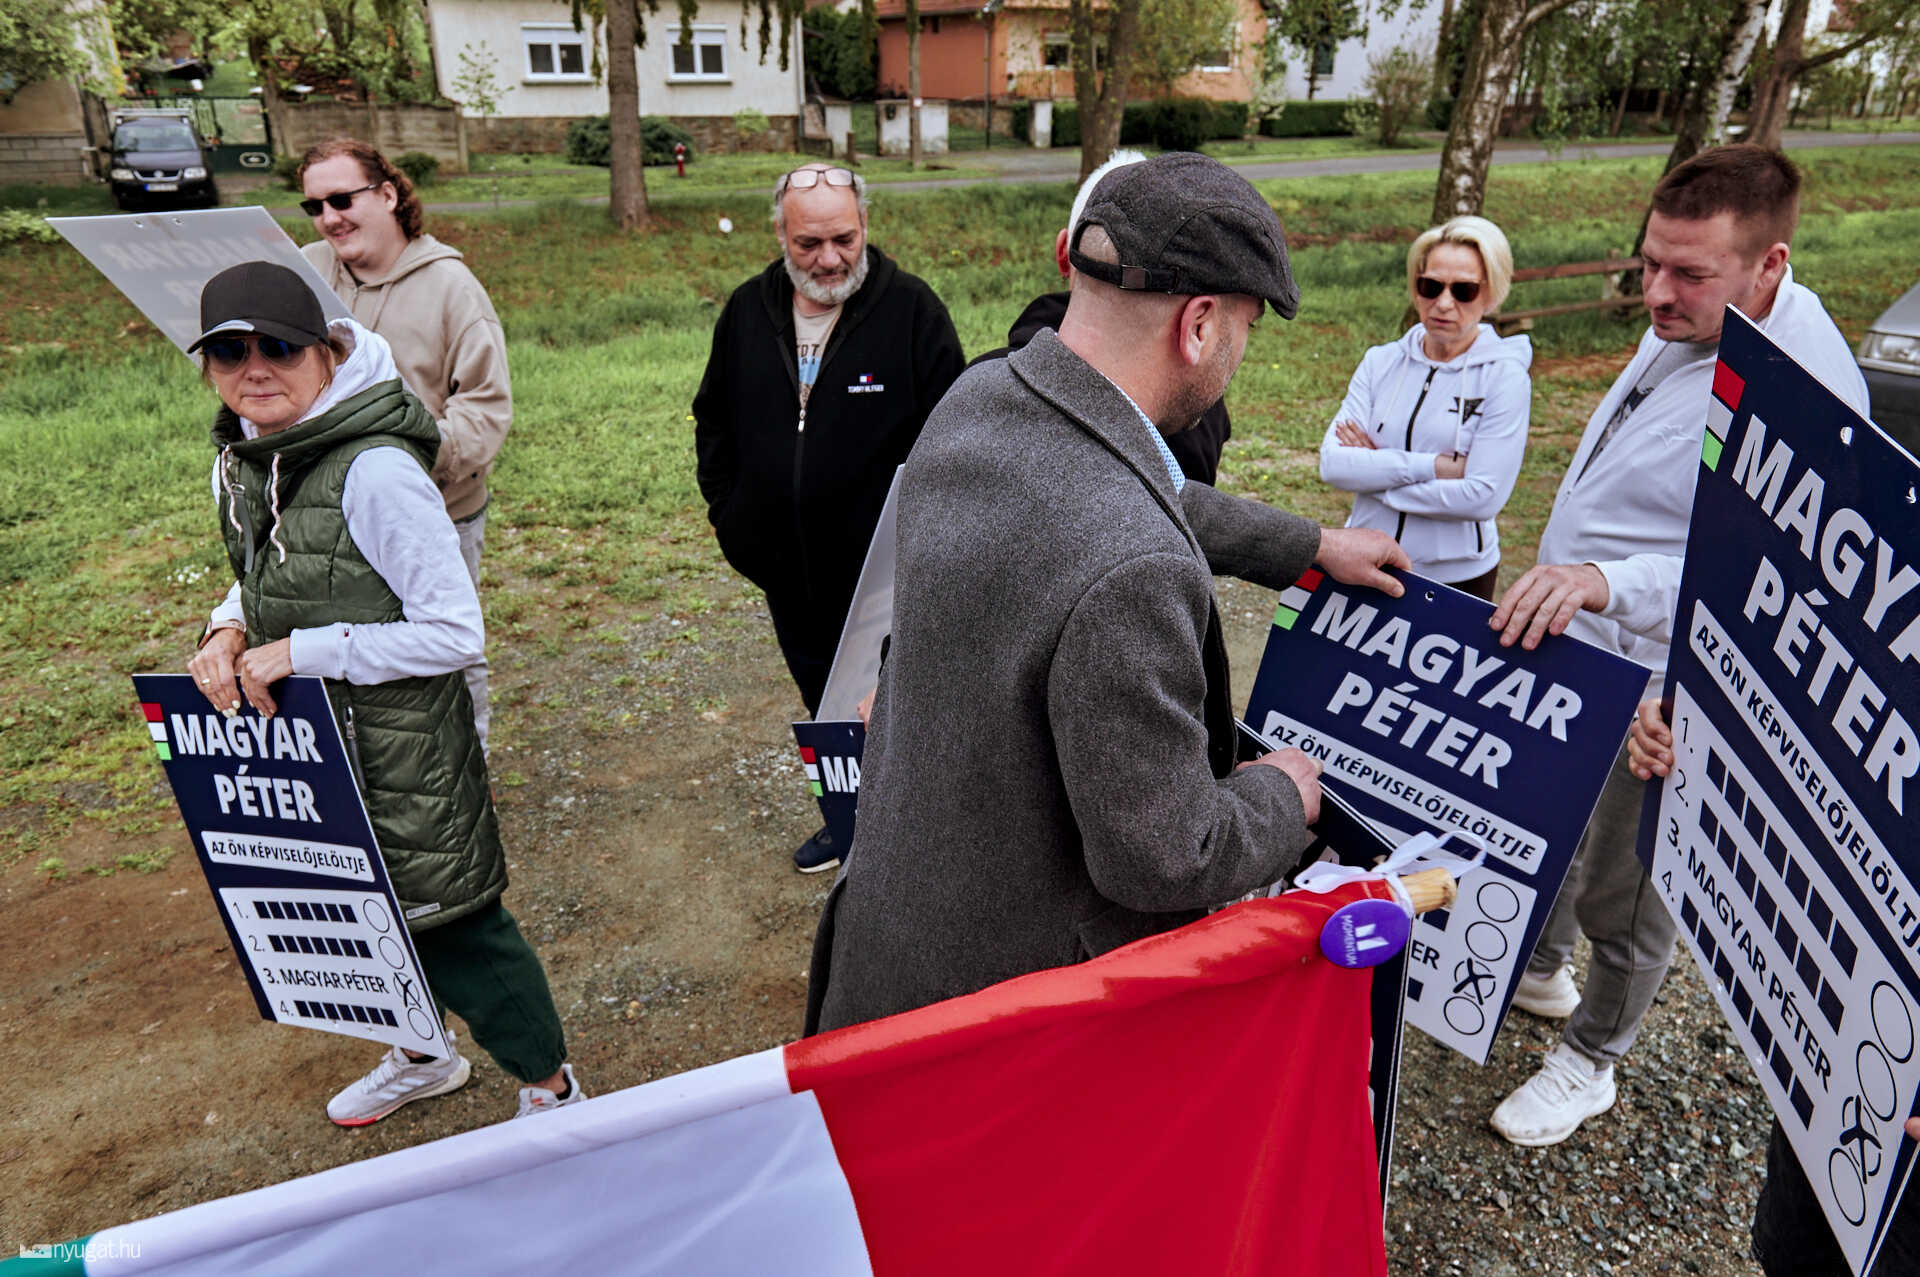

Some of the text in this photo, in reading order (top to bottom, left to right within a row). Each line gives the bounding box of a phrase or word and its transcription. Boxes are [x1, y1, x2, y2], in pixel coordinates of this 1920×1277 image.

[1311, 591, 1583, 743] MAGYAR
[1743, 556, 1920, 817] PÉTER
[171, 714, 324, 763] MAGYAR
[1326, 671, 1513, 789] PÉTER
[1682, 717, 1694, 754] 1.
[213, 764, 323, 823] PÉTER
[1270, 725, 1537, 861] AZ ÖN KÉPVISELŐJELÖLTJE
[1674, 768, 1689, 808] 2.
[1696, 624, 1920, 956] AZ ÖN KÉPVISELŐJELÖLTJ
[211, 840, 227, 855] AZ
[249, 841, 367, 875] KÉPVISELŐJELÖLTJE
[1660, 870, 1675, 902] 4.
[232, 901, 249, 919] 1.
[249, 935, 265, 952] 2.
[1667, 816, 1833, 1093] 3. MAGYAR PÉTER
[263, 968, 390, 994] 3. MAGYAR PÉTER
[280, 1000, 294, 1016] 4.
